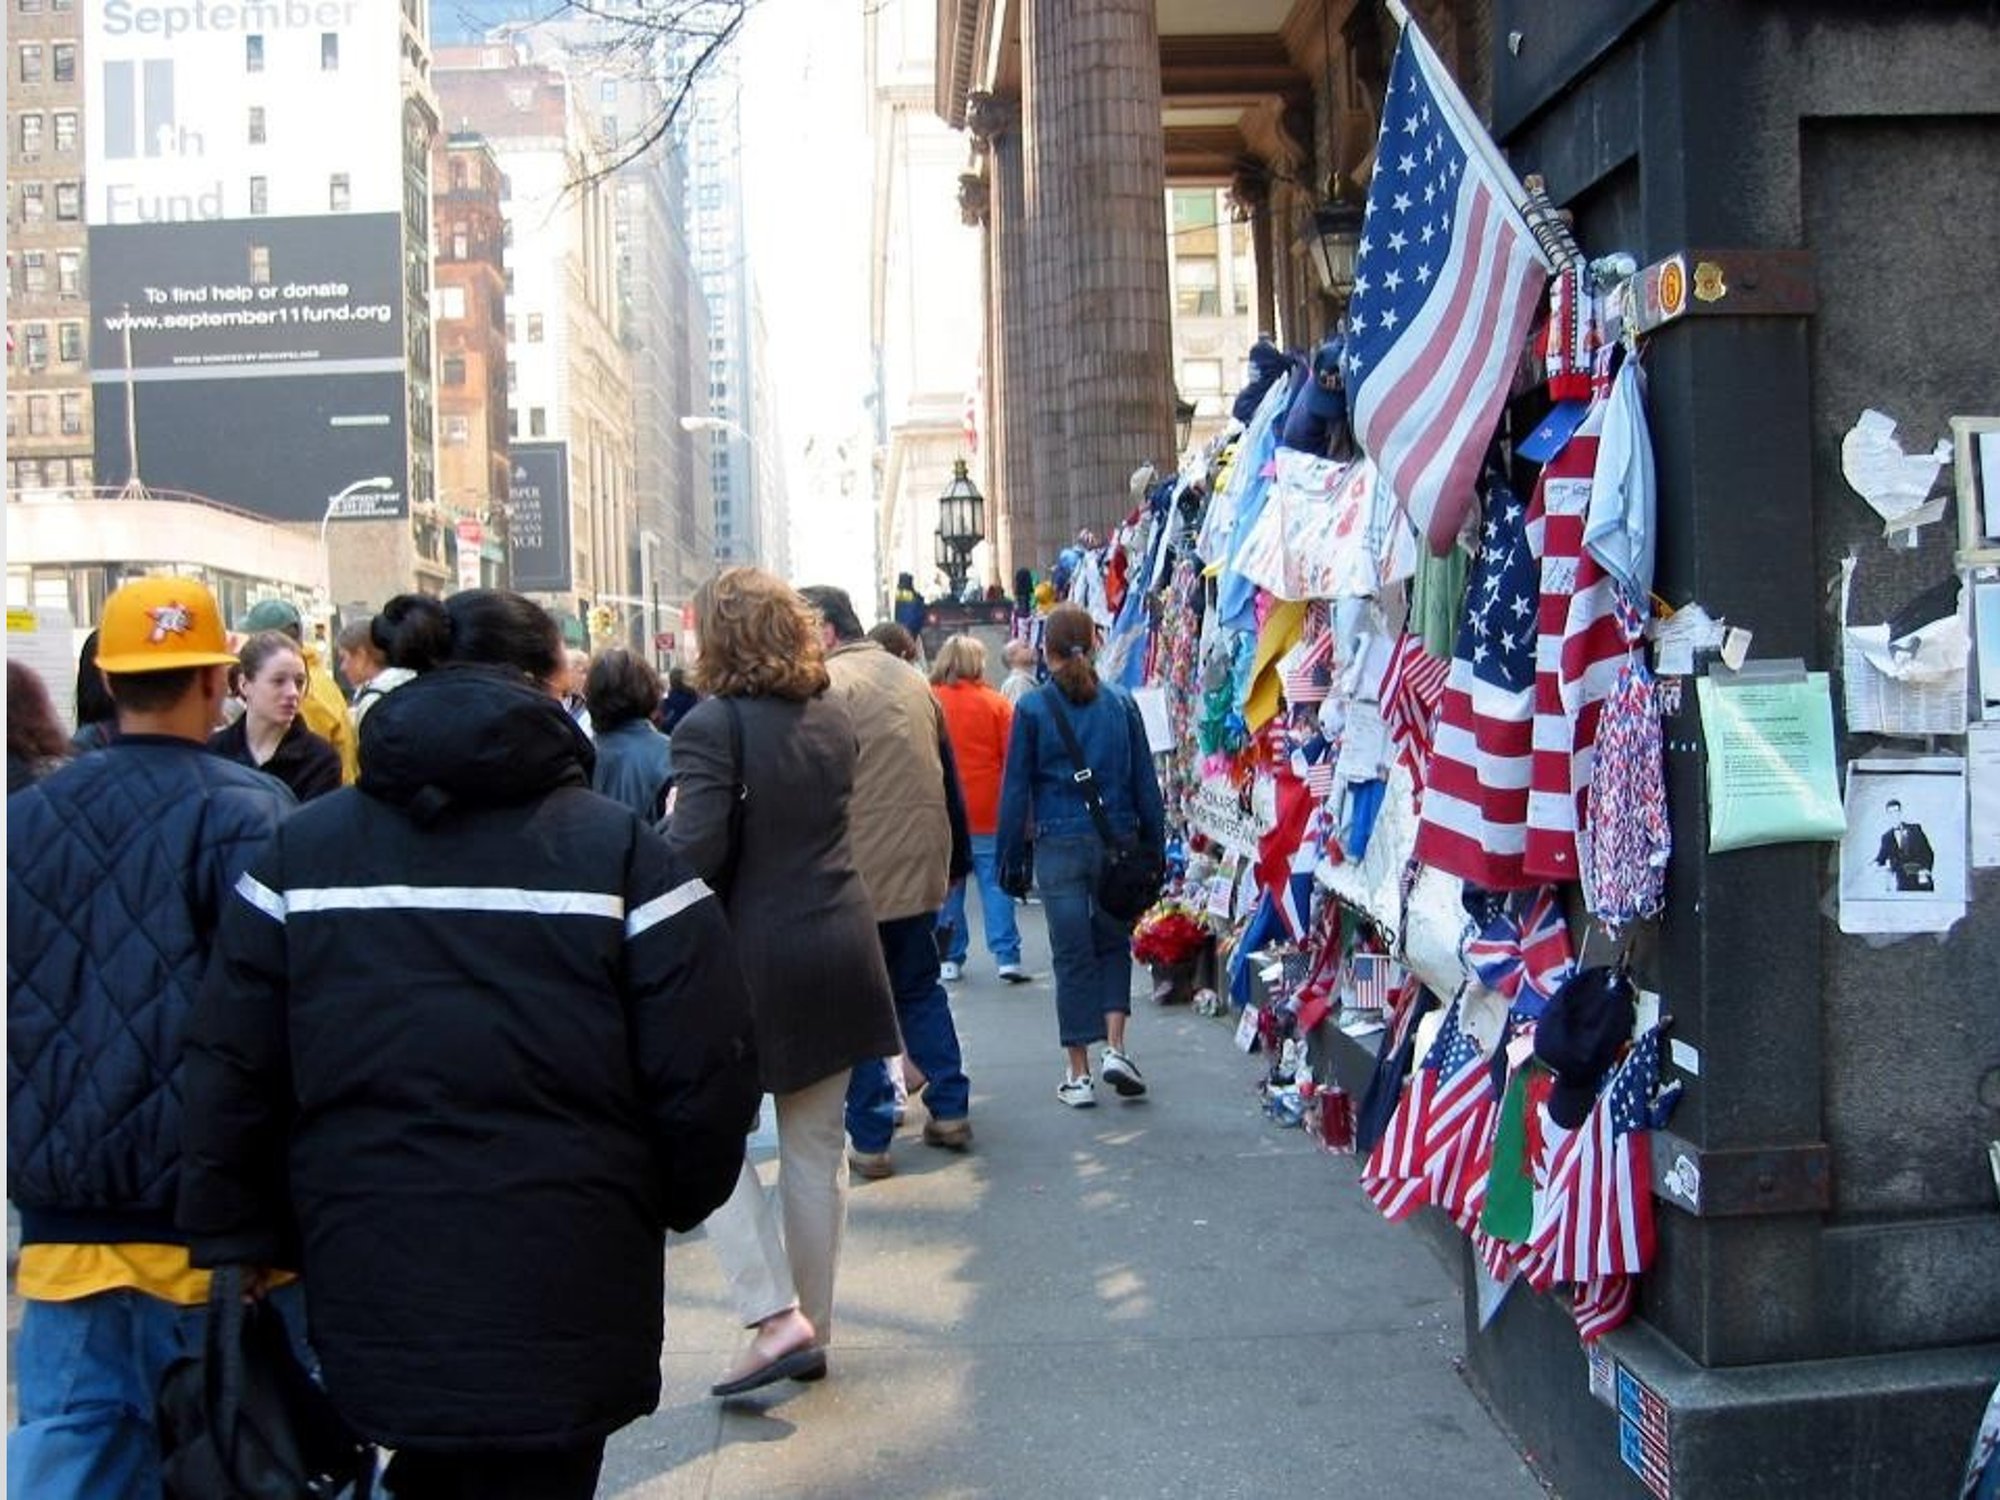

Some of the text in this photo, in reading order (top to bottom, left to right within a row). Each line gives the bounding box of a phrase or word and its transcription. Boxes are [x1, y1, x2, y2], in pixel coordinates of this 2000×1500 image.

[102, 0, 357, 39] September
[106, 180, 224, 225] Fund
[145, 282, 349, 304] To find help or donate
[105, 303, 392, 333] www.september11fund.org
